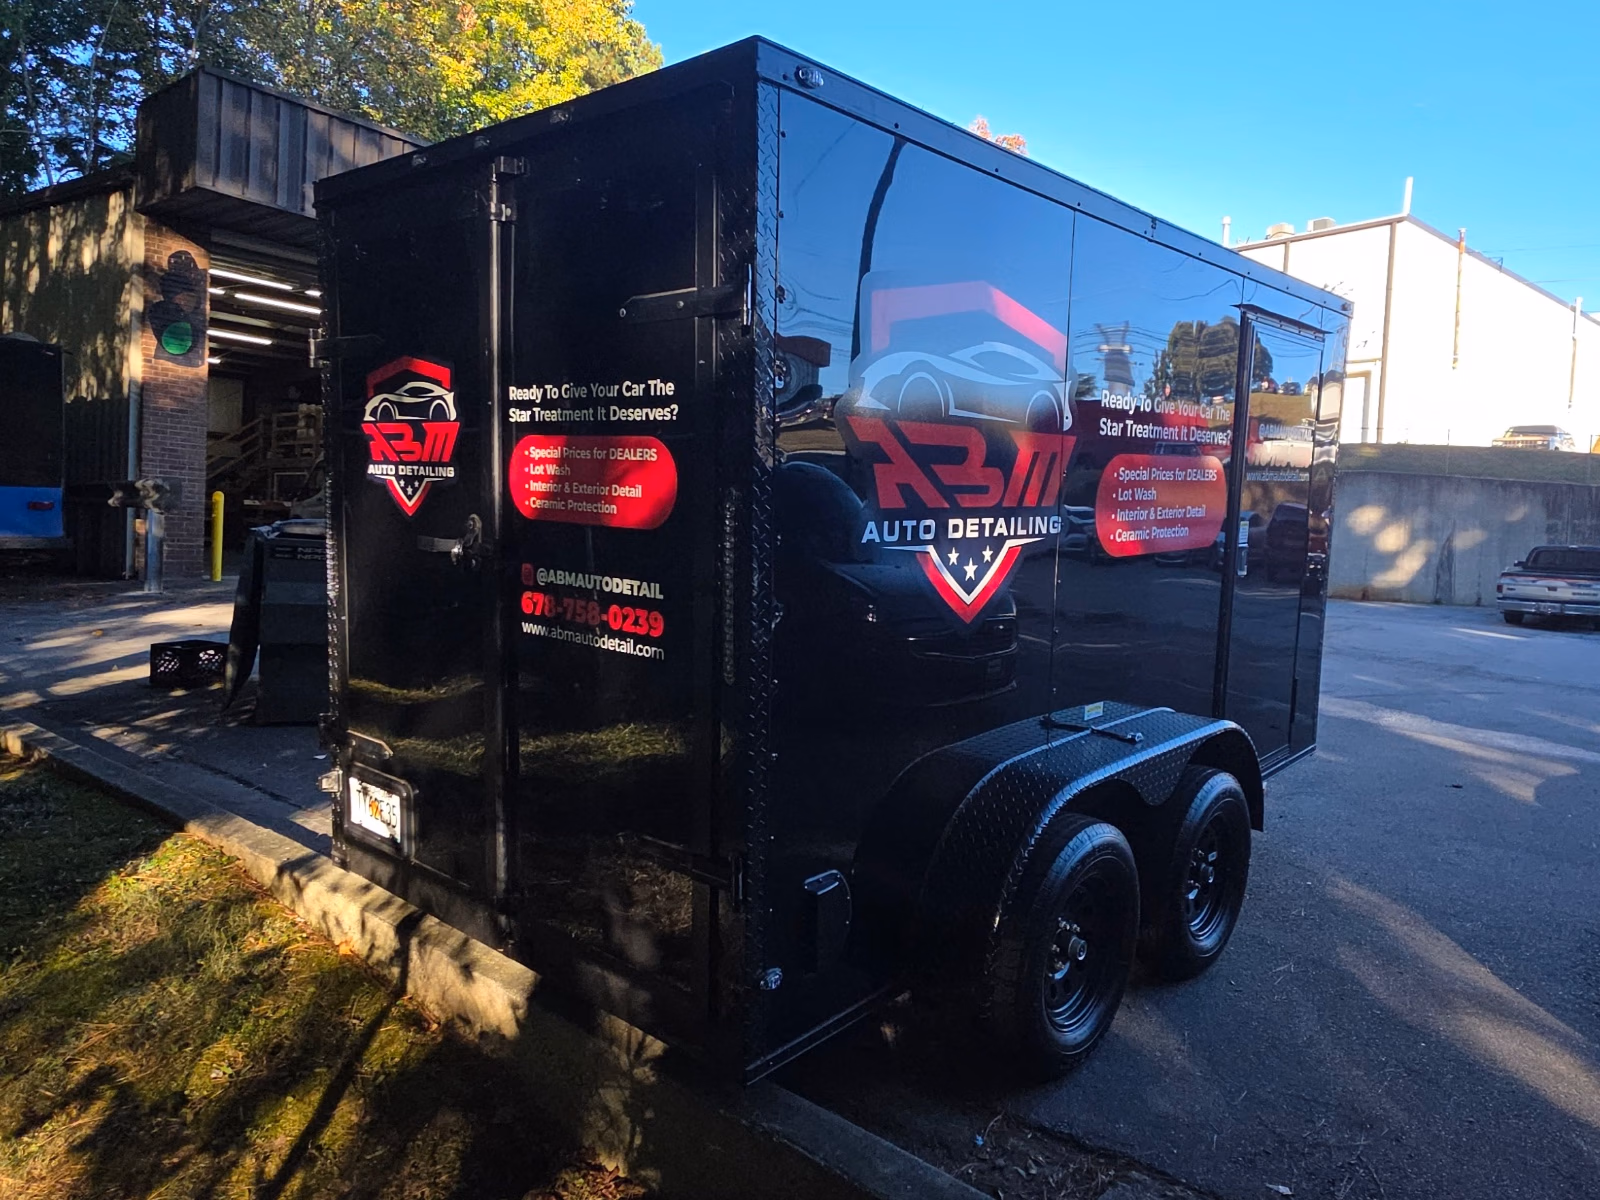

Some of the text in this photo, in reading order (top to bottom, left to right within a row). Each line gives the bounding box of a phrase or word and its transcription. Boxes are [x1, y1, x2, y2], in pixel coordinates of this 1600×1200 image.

[509, 379, 675, 403] Ready To Give Your Car The
[509, 404, 679, 422] Star Treatment It Deserves?
[1101, 390, 1231, 421] Ready To Give Your Car The
[1100, 418, 1232, 445] Star Treatment It Deserves?
[529, 446, 658, 461] Special Prices for DEALERS
[367, 464, 455, 477] AUTO DETAILING
[530, 464, 571, 476] Lot Wash
[1119, 466, 1217, 483] Special Prices for DEALERS
[530, 480, 642, 498] Interior & Exterior Detail
[1118, 487, 1157, 501] Lot Wash
[530, 497, 617, 515] Ceramic Protection
[1117, 504, 1206, 521] Interior & Exterior Detail
[861, 516, 1062, 543] AUTO DETAILING
[1115, 524, 1189, 542] Ceramic Protection
[536, 567, 664, 599] @ABMAUTODETAIL
[521, 591, 664, 637] 678-758-0239
[521, 621, 664, 660] www.abmautodetail.com
